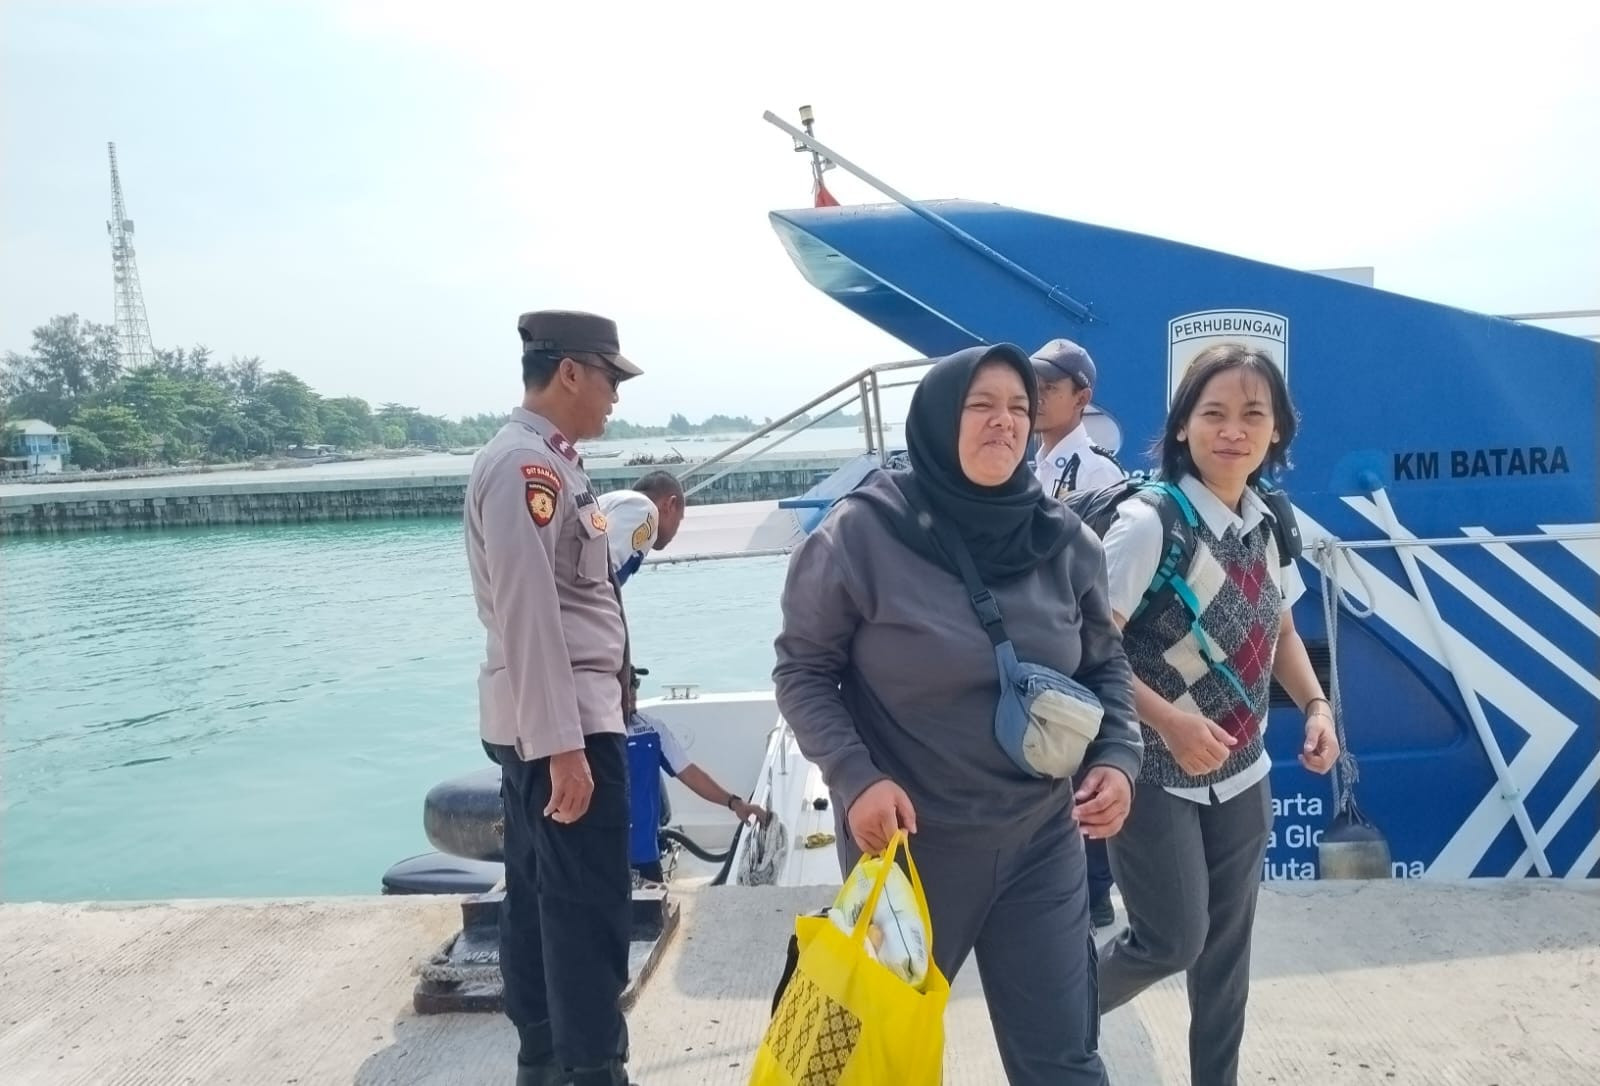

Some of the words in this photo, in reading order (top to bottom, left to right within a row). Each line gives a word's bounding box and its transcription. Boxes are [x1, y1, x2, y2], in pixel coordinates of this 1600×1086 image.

[1174, 318, 1283, 337] PERHUBUNGAN
[1393, 451, 1440, 481] KM
[1450, 445, 1570, 479] BATARA
